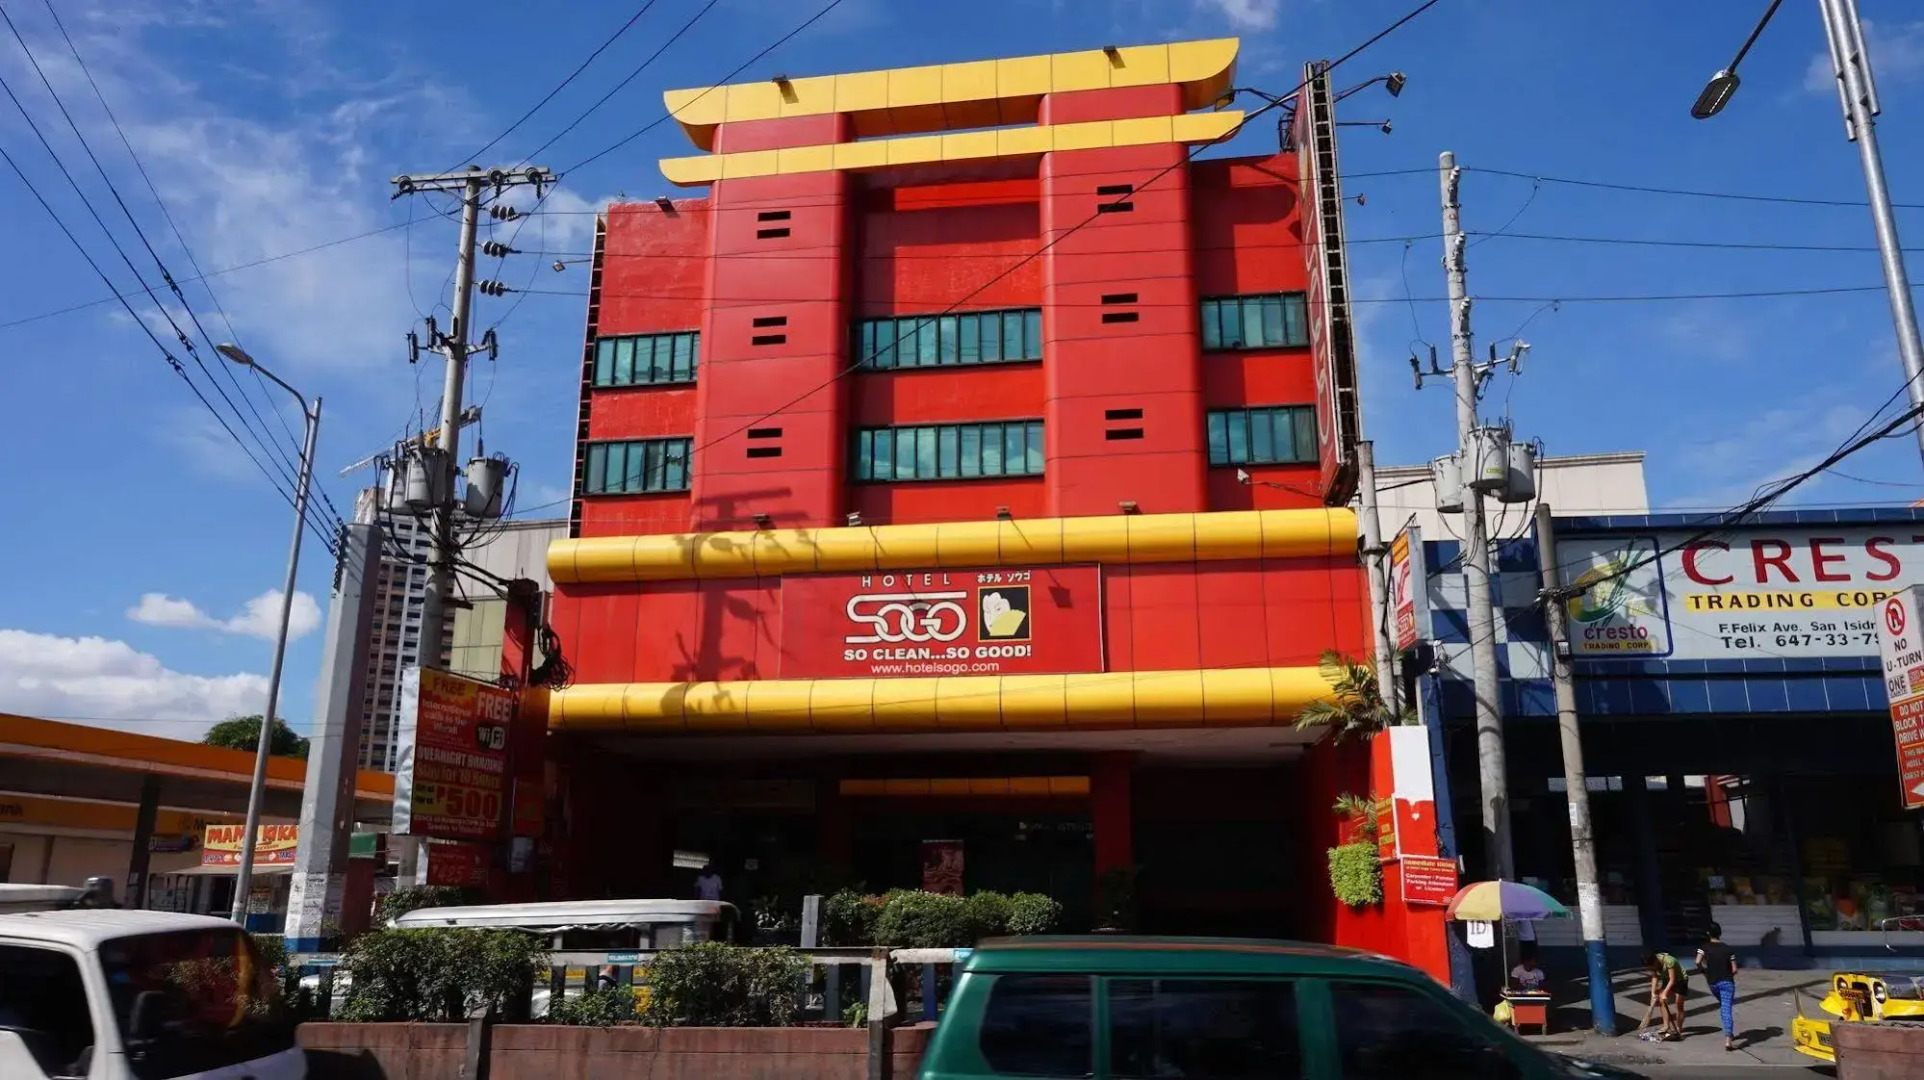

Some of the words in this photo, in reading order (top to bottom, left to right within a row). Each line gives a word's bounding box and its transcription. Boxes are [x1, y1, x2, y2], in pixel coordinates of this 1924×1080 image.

[861, 573, 951, 588] HOTEL
[977, 573, 1002, 584] ホテル
[1007, 570, 1031, 582] ソウゴ
[1689, 592, 1814, 610] TRADING
[1836, 591, 1901, 607] COR
[845, 590, 968, 645] SOGO
[1584, 623, 1648, 640] cresto
[1718, 622, 1767, 634] F.Felix
[1772, 622, 1803, 632] Ave.
[1810, 620, 1837, 632] San
[1720, 635, 1761, 649] Tel.
[1894, 638, 1907, 652] NO
[843, 648, 868, 661] SO
[872, 646, 970, 660] CLEAN...SO
[974, 644, 1032, 659] GOOD!
[1886, 649, 1922, 672] U-TURN
[870, 661, 1000, 675] www.hotelsogo.com
[433, 675, 466, 698] FREE
[1888, 675, 1906, 692] ONE
[476, 691, 511, 722] FREE
[1899, 704, 1909, 717] DO
[1909, 700, 1923, 714] NOT
[1895, 715, 1917, 731] BLOCK
[1898, 729, 1919, 744] DRIVE
